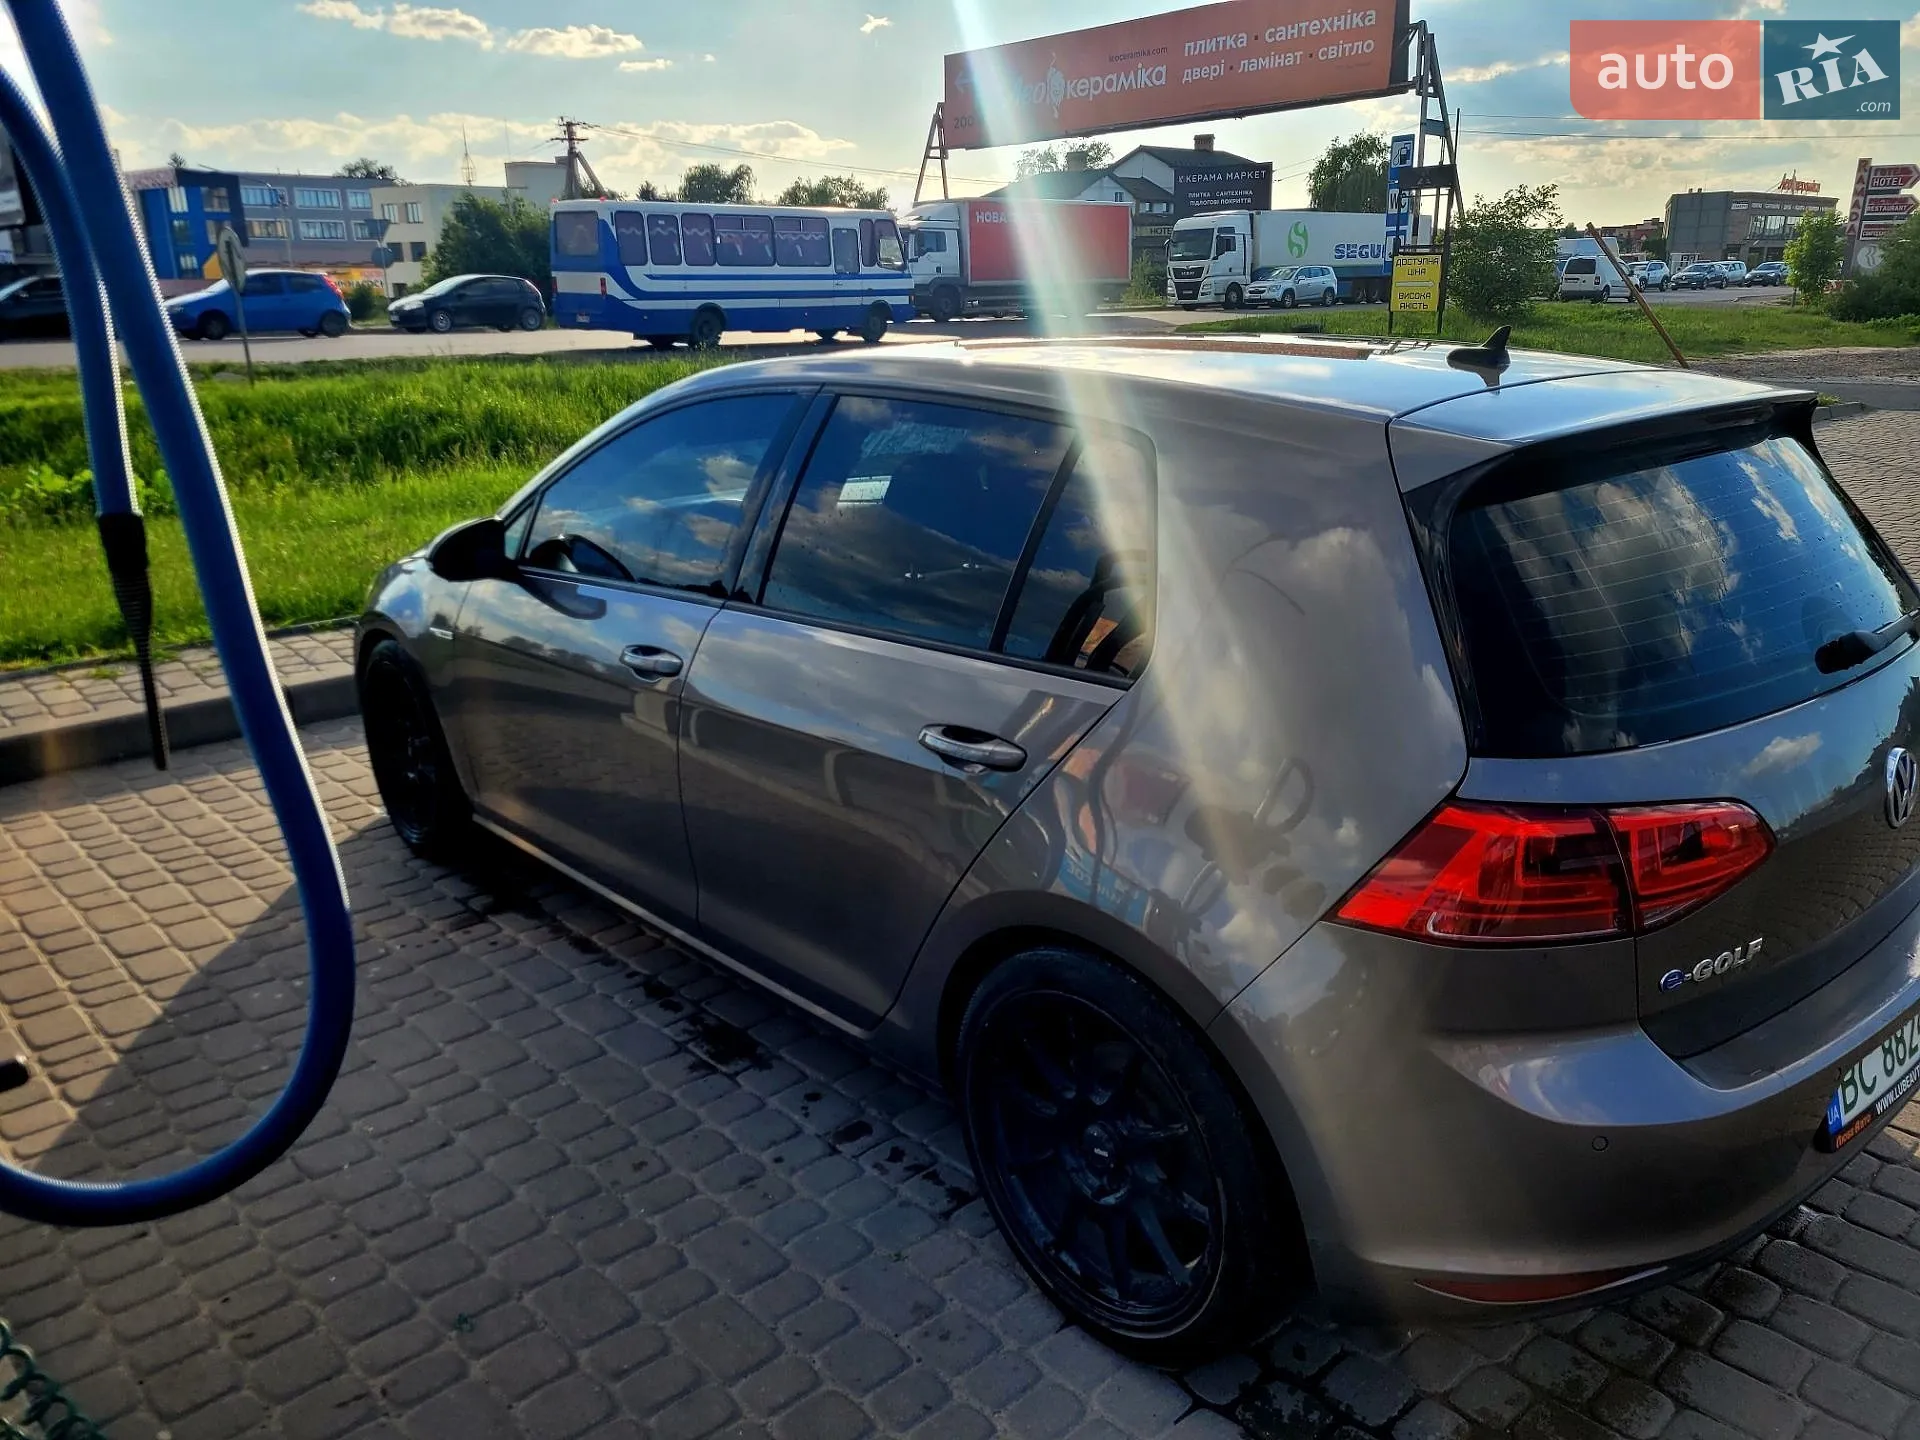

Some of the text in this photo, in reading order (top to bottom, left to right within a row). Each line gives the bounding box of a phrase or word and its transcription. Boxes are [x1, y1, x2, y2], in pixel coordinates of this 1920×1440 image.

[1184, 9, 1376, 57] плитка сантехніка
[1182, 39, 1375, 84] двері ламінат світло
[1067, 62, 1167, 101] кераміка
[1185, 170, 1267, 183] КЕРАМА МАРКЕТ
[1872, 177, 1904, 187] HOTEL
[1866, 204, 1907, 212] RESTAURANT
[976, 211, 1008, 224] НОВА
[1150, 227, 1174, 235] HOTE
[1396, 257, 1440, 267] ДОСТУПНА
[1407, 268, 1426, 276] ЦІНА
[1398, 292, 1431, 300] ВИСОКА
[1399, 302, 1429, 310] ЯКІСТЬ
[1660, 937, 1763, 993] e-GOLF
[1840, 1013, 1920, 1116] BC 882
[1827, 1104, 1840, 1126] UA
